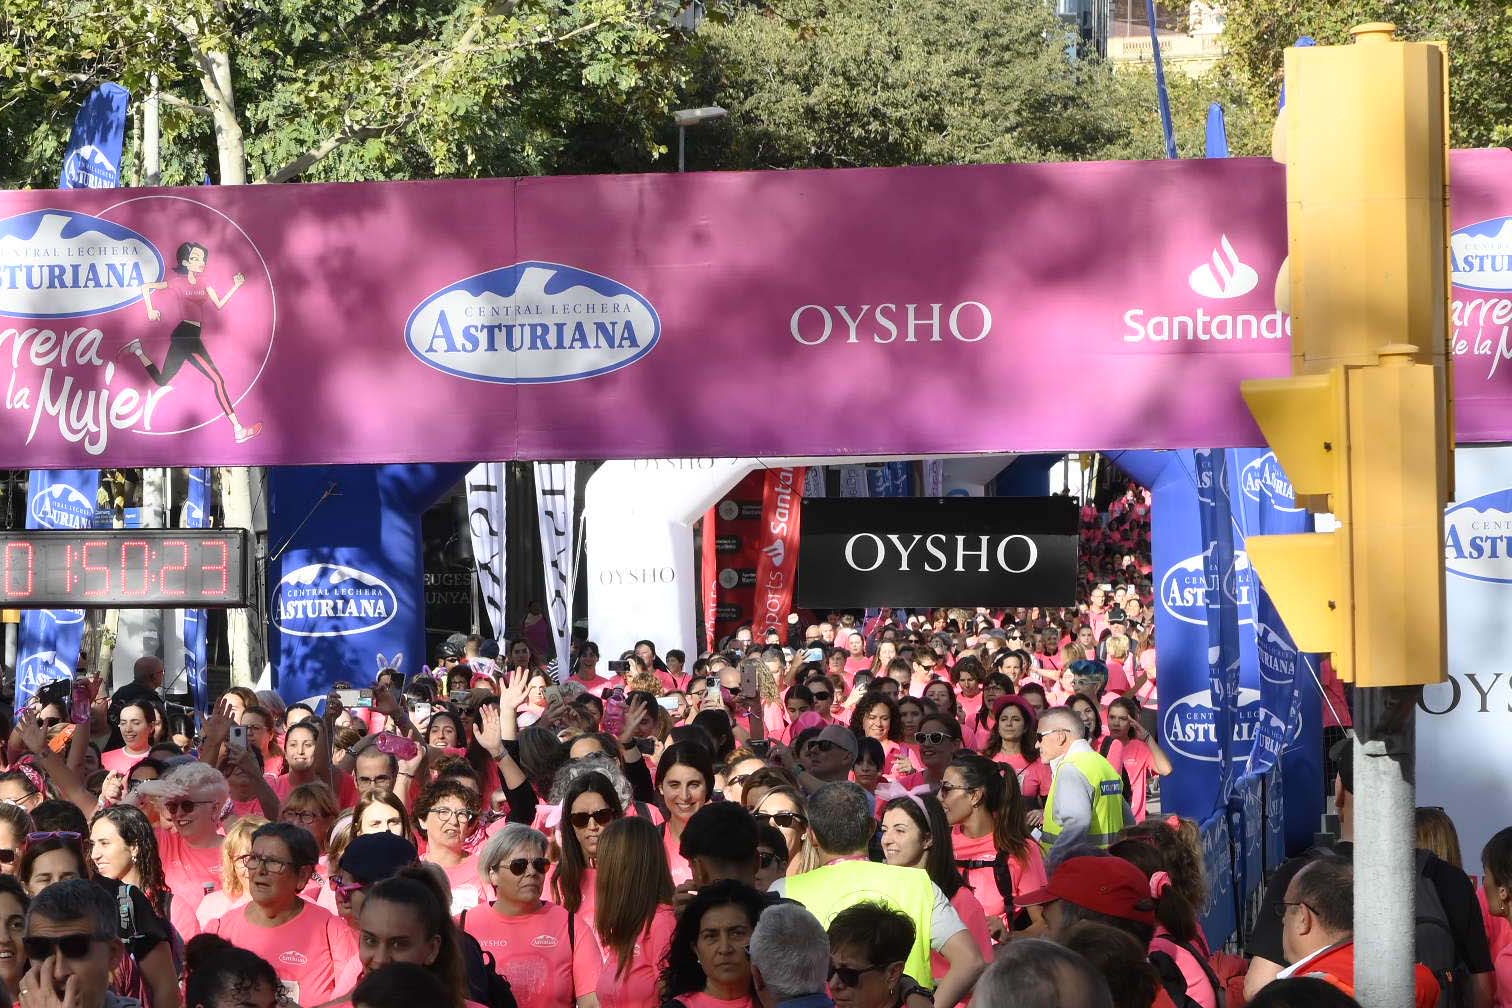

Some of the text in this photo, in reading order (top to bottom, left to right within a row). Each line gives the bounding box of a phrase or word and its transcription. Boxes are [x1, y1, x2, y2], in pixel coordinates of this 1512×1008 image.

[67, 245, 140, 257] LECHERA
[425, 309, 641, 353] ASTURIANA
[465, 302, 632, 318] CENTRAL LECHERA
[790, 301, 993, 345] OYSHO
[5, 369, 32, 410] la
[24, 361, 176, 456] Mujer
[4, 541, 229, 597] 01:50:23
[845, 532, 1038, 573] OYSHO
[275, 593, 389, 621] ASTURIANA
[287, 587, 384, 598] CENTRAL LECHERA
[1417, 673, 1512, 716] OY
